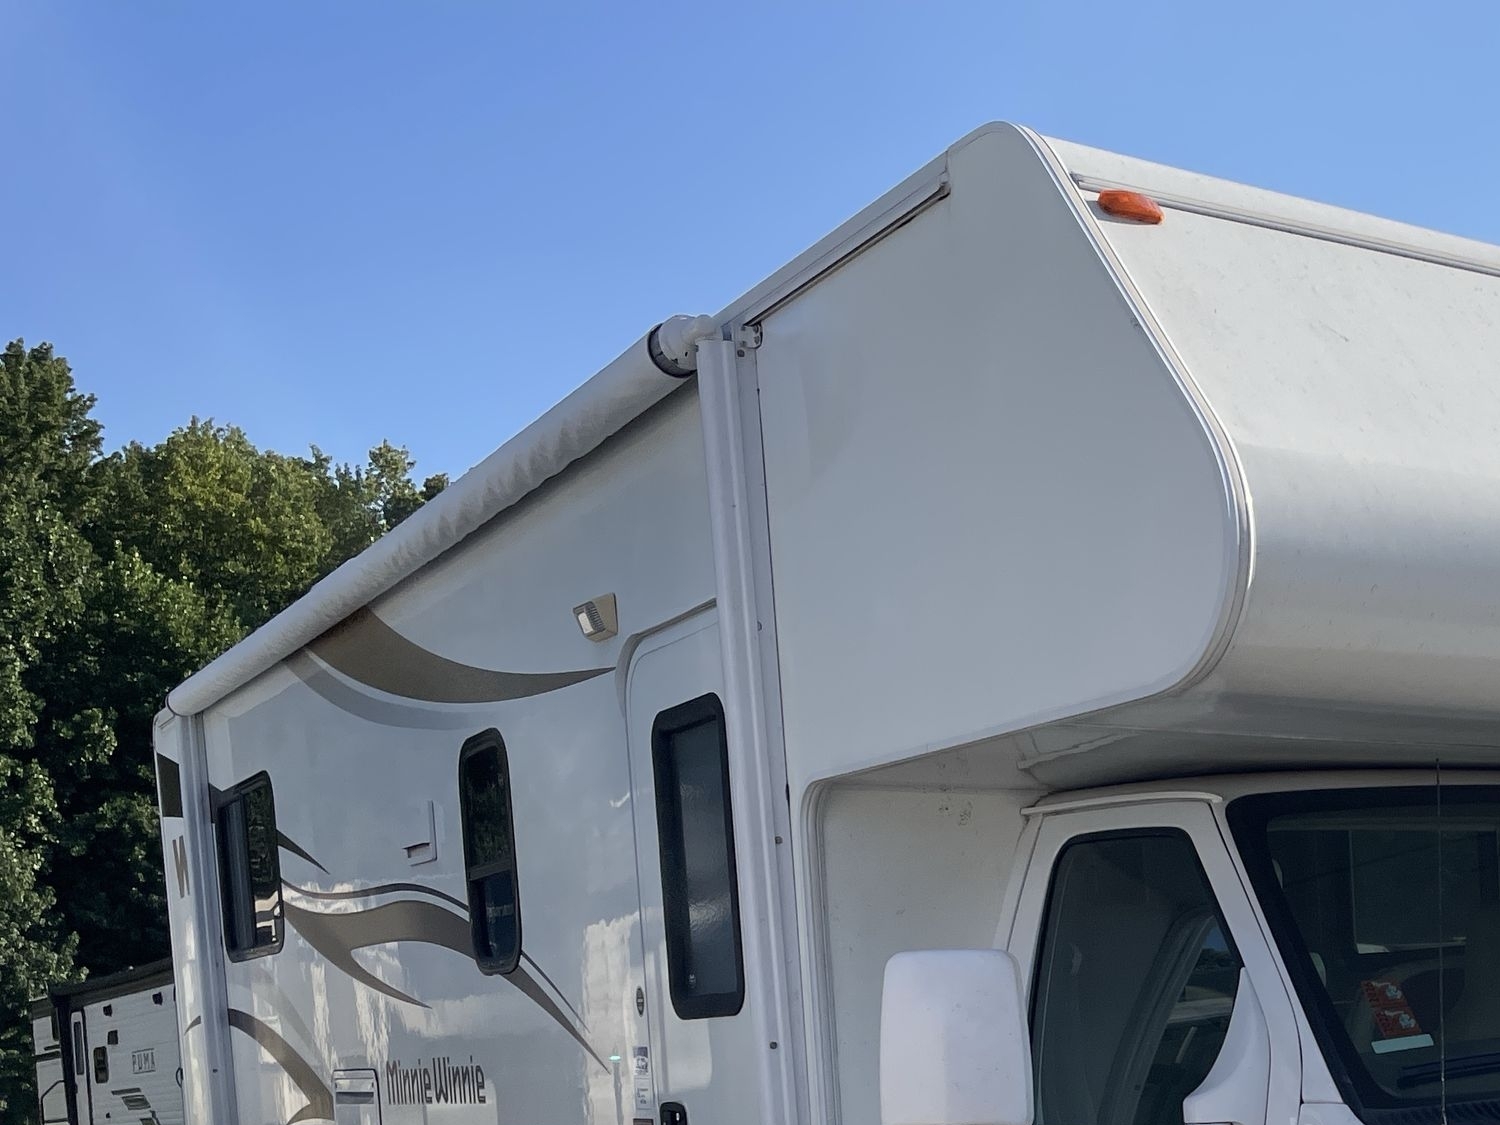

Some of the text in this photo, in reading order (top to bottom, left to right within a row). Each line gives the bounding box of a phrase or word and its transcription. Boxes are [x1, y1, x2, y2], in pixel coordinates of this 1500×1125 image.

[131, 1051, 156, 1073] PUMA
[386, 1055, 487, 1105] Minnie Winnie
